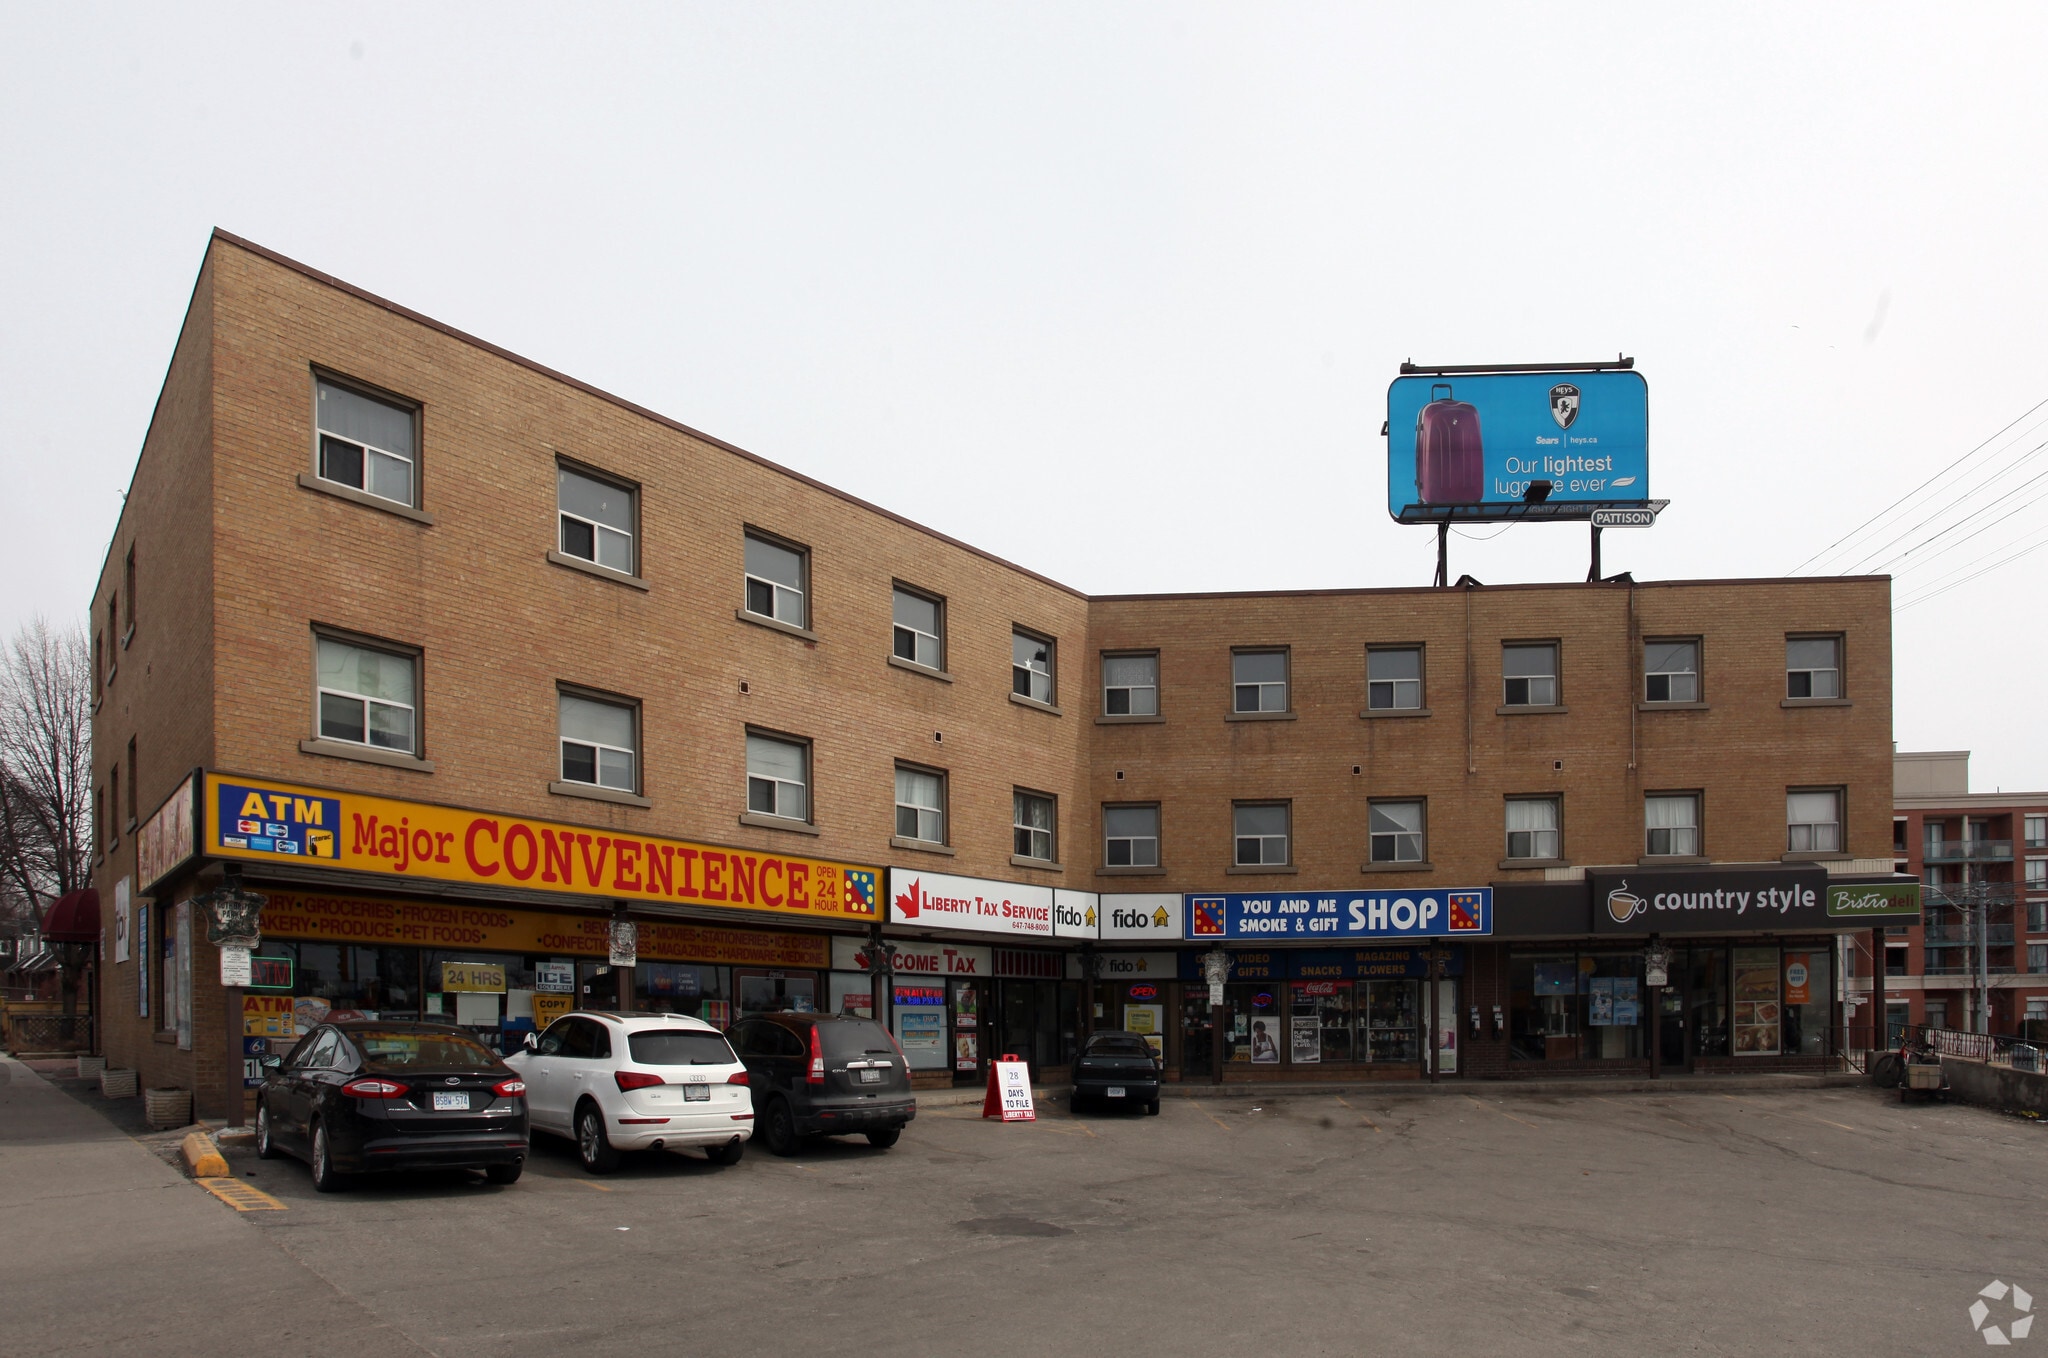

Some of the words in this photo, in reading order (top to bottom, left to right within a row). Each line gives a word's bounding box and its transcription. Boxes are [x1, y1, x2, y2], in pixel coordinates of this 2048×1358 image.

[1555, 386, 1573, 395] HEYS
[1535, 436, 1559, 445] Sears
[1570, 436, 1598, 446] heys.ca
[1505, 456, 1539, 474] Our
[1544, 455, 1613, 477] lightest
[1570, 478, 1607, 493] ever
[1596, 512, 1651, 524] PATTISON
[239, 791, 323, 826] ATM
[352, 812, 455, 872] Major
[464, 818, 809, 910] CONVENIENCE
[816, 865, 837, 879] OPEN
[816, 880, 837, 899] 24
[814, 898, 839, 912] HOUR
[922, 890, 972, 914] LIBERTY
[975, 896, 998, 917] TAX
[1002, 899, 1050, 922] SERVICE
[1242, 899, 1272, 914] YOU
[1277, 899, 1311, 913] AND
[1316, 899, 1337, 913] ME
[1653, 887, 1751, 915] country
[1756, 883, 1816, 914] style
[304, 897, 394, 920] GROCERIES
[402, 905, 459, 925] FROZEN
[462, 910, 508, 928] FOODS
[1055, 904, 1082, 927] fido
[1112, 909, 1149, 928] fido
[1348, 897, 1439, 931] SHOP
[319, 917, 394, 938] PRODUCE
[402, 923, 428, 941] PET
[432, 925, 481, 944] FOODS
[1012, 921, 1050, 932] 647-748-8000
[1239, 918, 1288, 933] SMOKE
[1295, 918, 1305, 932] &
[1309, 917, 1339, 932] GIFT
[655, 926, 697, 943] MOVIES
[701, 929, 770, 947] STATIONERIES
[774, 936, 793, 949] ICE
[794, 937, 824, 951] CREAM
[656, 940, 718, 959] MAGAZINES
[722, 946, 777, 962] HARDWARE
[780, 951, 824, 964] MEDICINE
[1237, 953, 1270, 964] VIDEO
[943, 949, 976, 973] TAX
[1109, 959, 1134, 973] fido
[251, 961, 290, 985] ATM
[1237, 966, 1269, 977] GIFTS
[1300, 965, 1343, 977] SNACKS
[1357, 964, 1406, 975] FLOWERS
[447, 970, 465, 984] 24
[471, 970, 502, 986] HRS
[537, 971, 573, 984] ICE
[1128, 986, 1159, 998] OPEN
[244, 996, 293, 1012] ATM
[539, 1000, 566, 1009] COPY
[1009, 1071, 1019, 1080] 28
[1007, 1089, 1025, 1098] DAYS
[1005, 1099, 1015, 1108] TO
[1015, 1099, 1030, 1108] FILE
